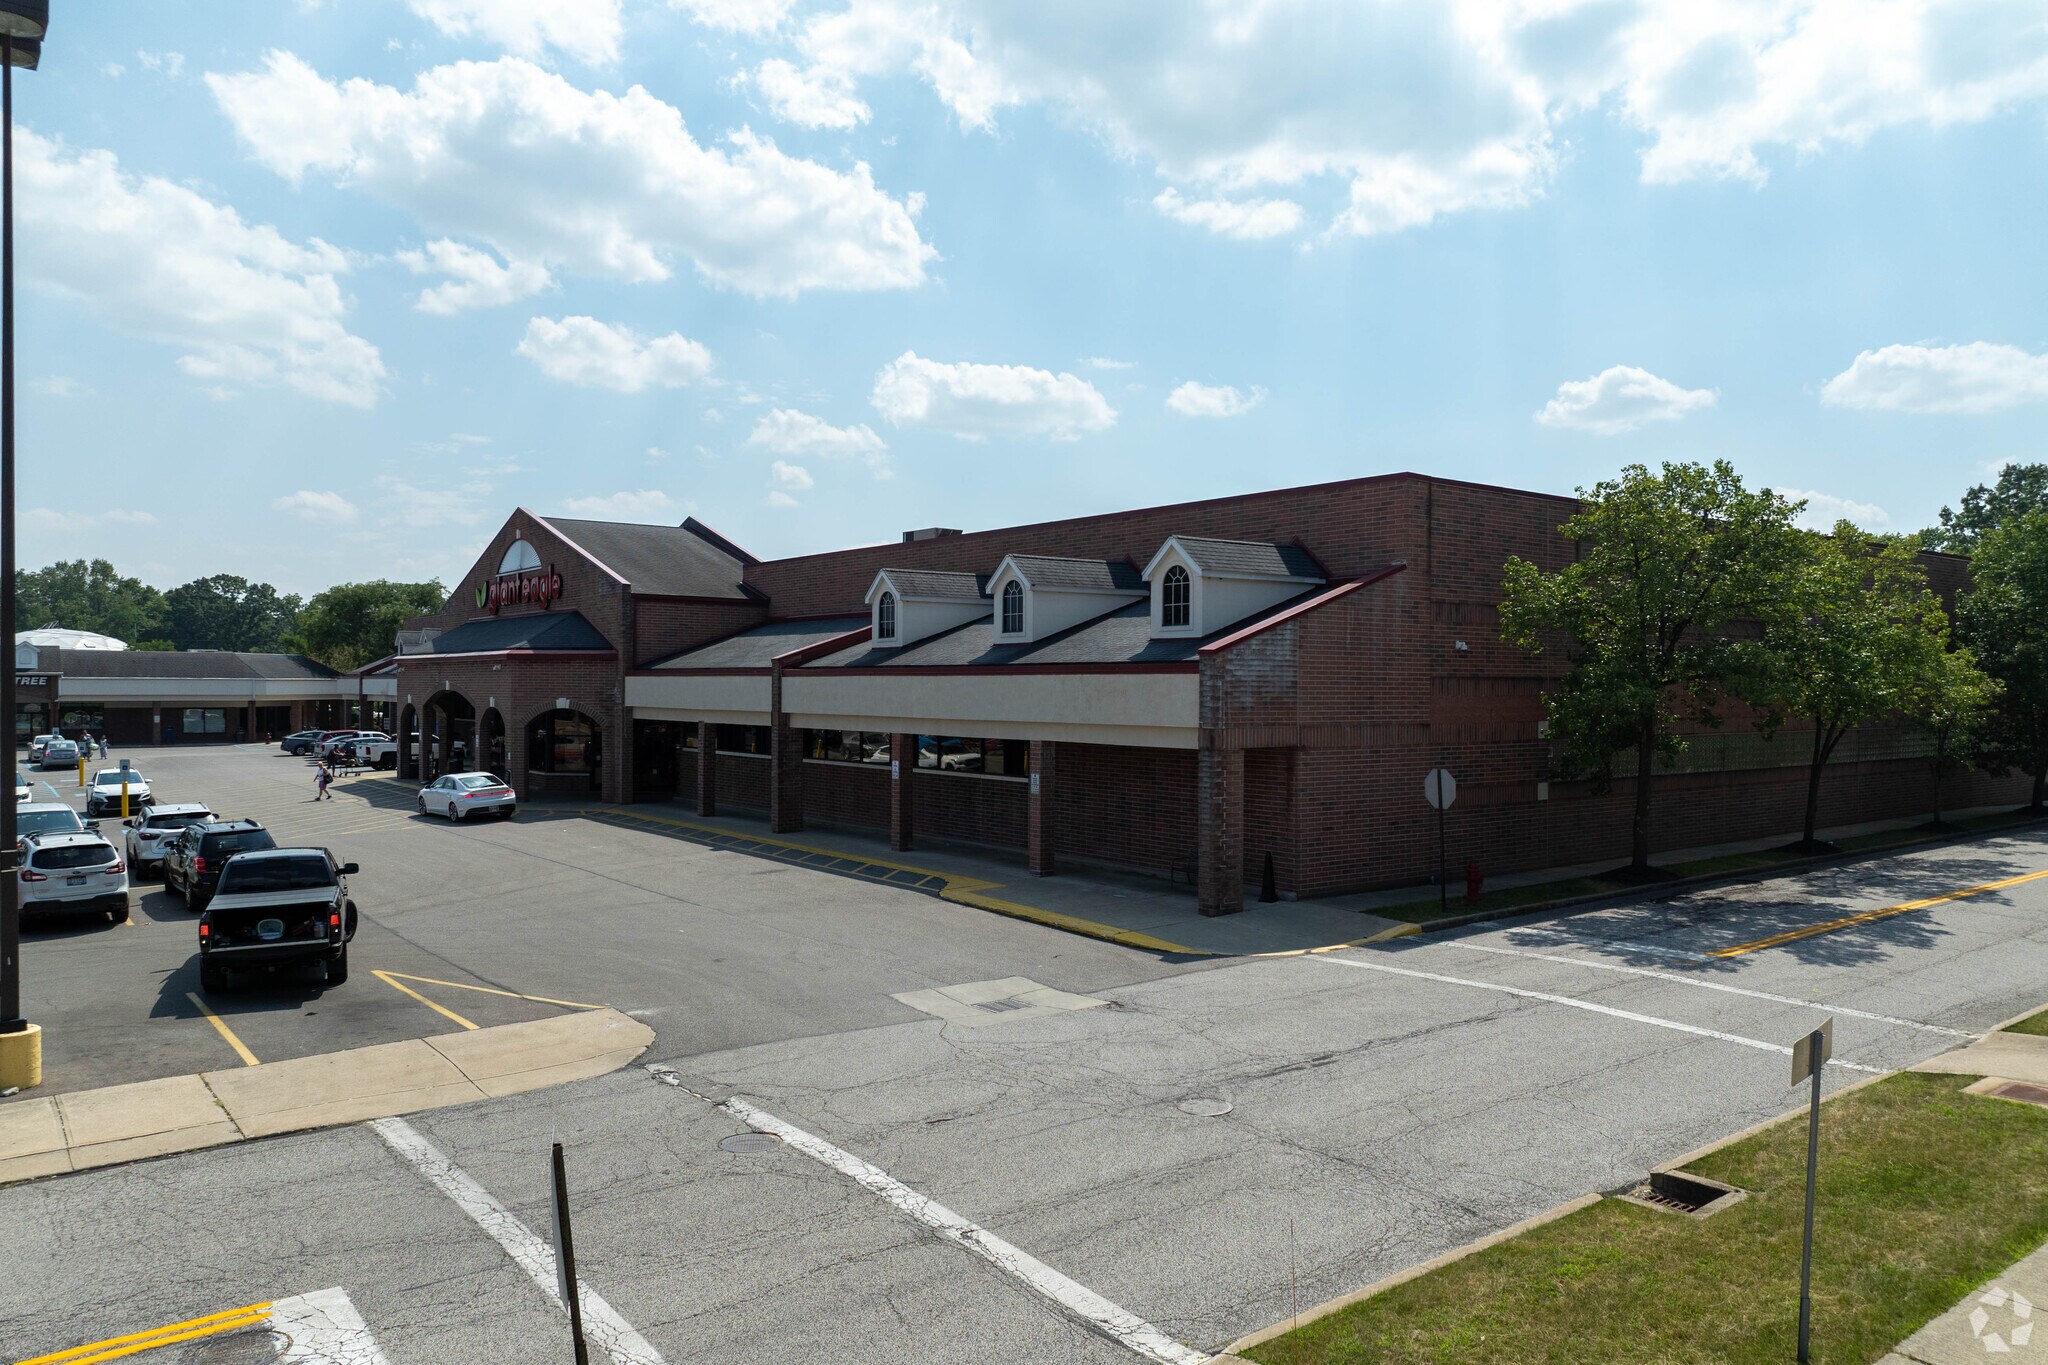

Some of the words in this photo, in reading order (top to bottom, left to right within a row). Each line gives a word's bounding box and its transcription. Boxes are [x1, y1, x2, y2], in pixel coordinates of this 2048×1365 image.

[488, 573, 520, 615] giant
[522, 564, 562, 610] eagle
[16, 676, 47, 685] TREE
